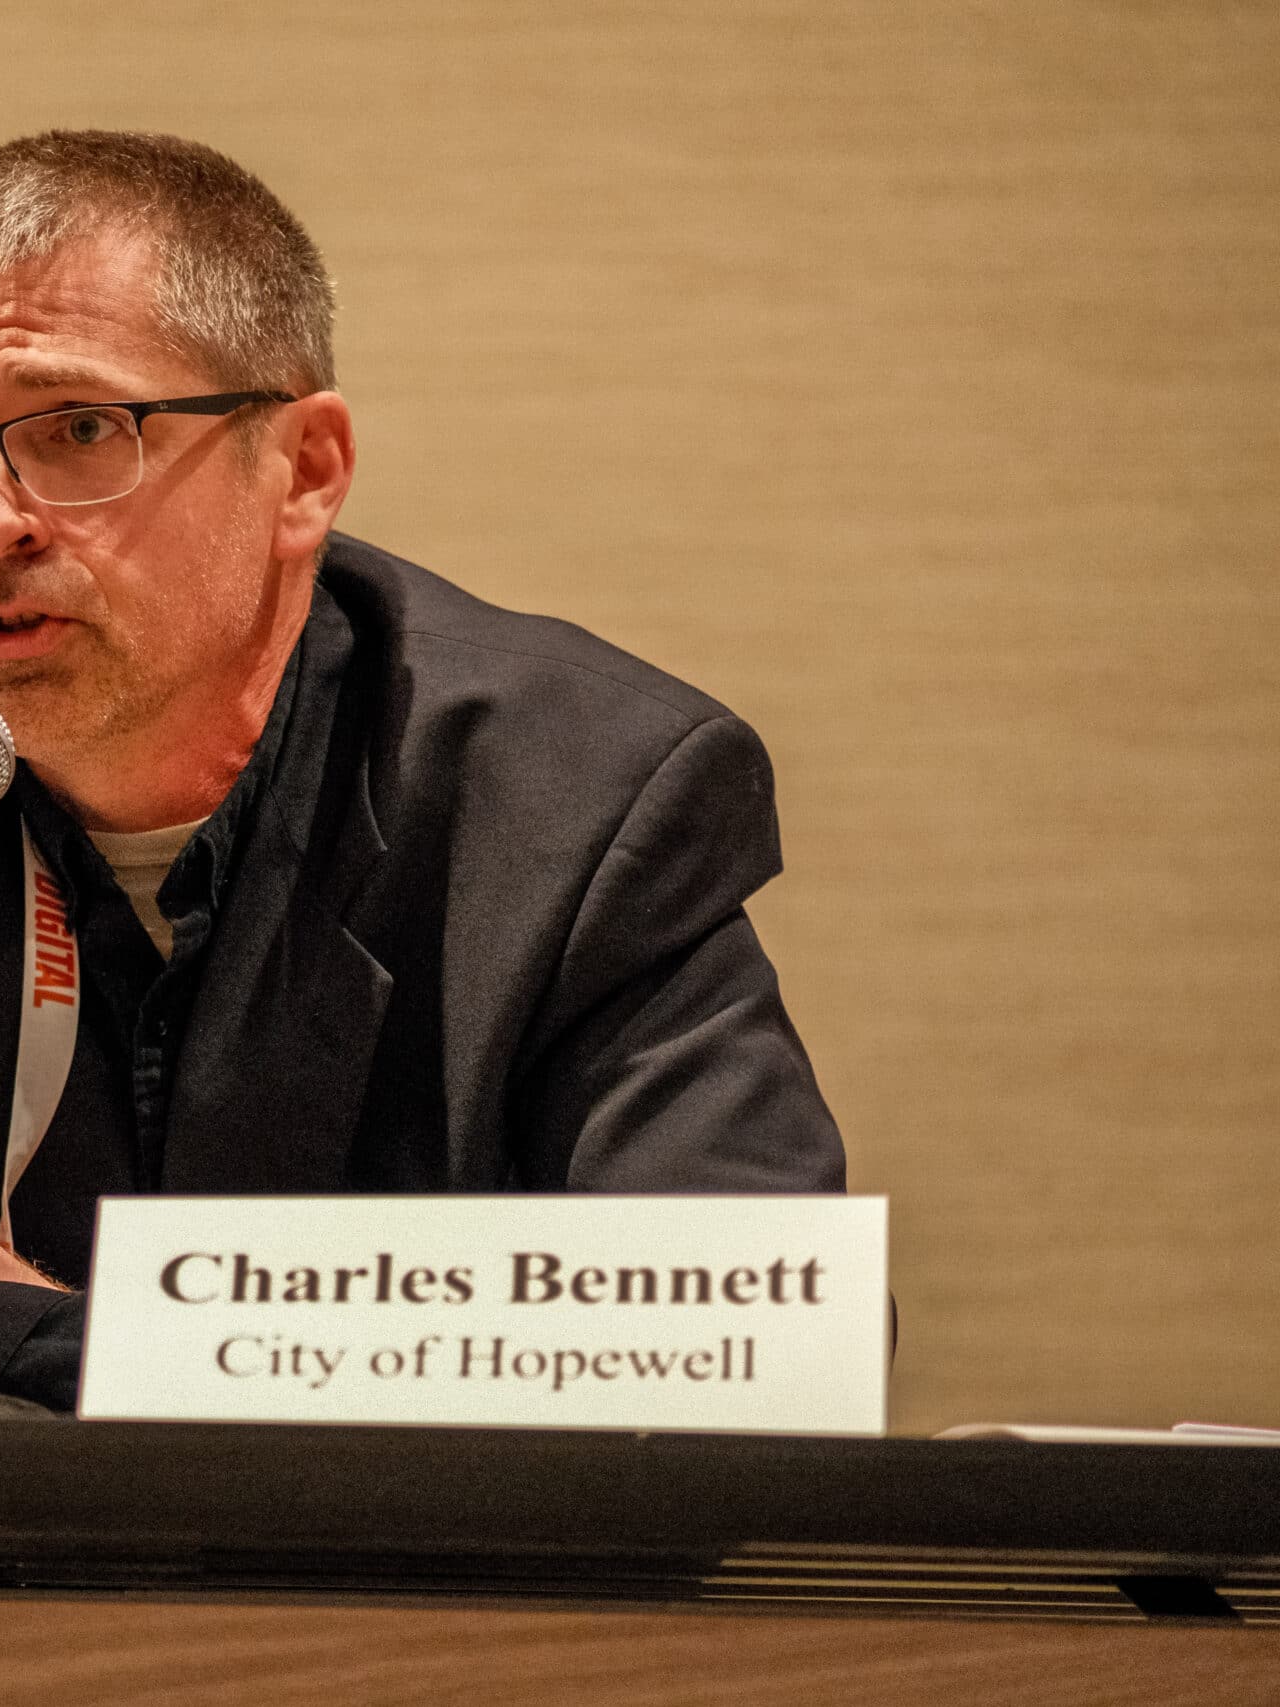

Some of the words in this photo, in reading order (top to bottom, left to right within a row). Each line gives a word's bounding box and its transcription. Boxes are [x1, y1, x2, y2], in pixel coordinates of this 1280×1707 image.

[33, 871, 76, 1009] DIGITAL
[158, 1252, 475, 1306] Charles
[508, 1252, 827, 1307] Bennett
[214, 1334, 346, 1391] City
[369, 1334, 445, 1379] of
[458, 1334, 757, 1392] Hopewell
